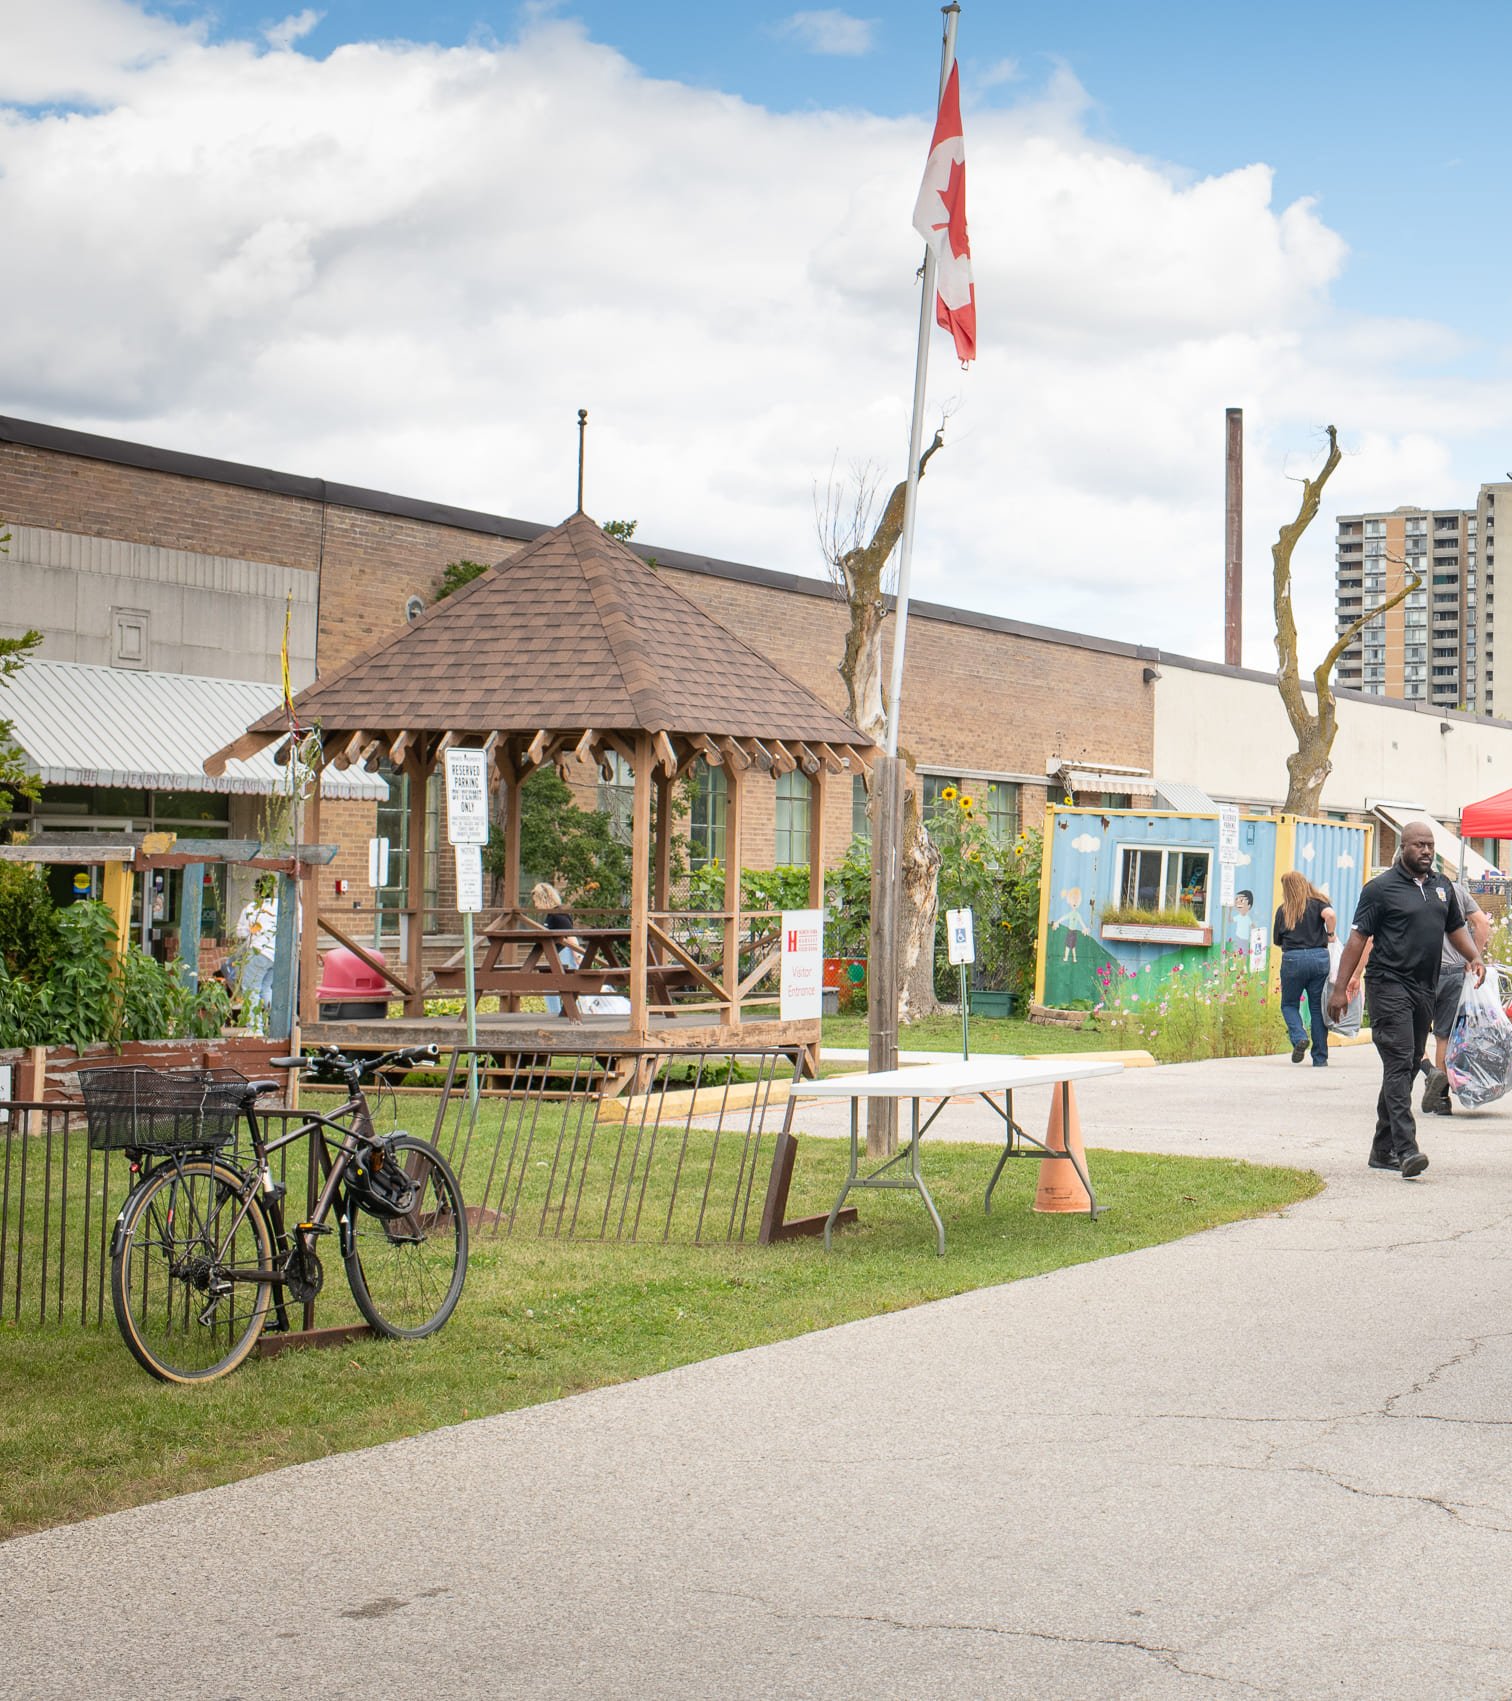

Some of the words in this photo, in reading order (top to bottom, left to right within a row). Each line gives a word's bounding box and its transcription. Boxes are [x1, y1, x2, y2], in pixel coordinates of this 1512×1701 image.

[452, 764, 480, 776] RESERVED
[75, 769, 97, 782] THE
[122, 773, 182, 787] LEARNING
[204, 776, 273, 793] ENRICHMENT
[454, 777, 479, 788] PARKING
[461, 801, 475, 813] ONLY
[787, 930, 798, 952] H
[792, 966, 812, 977] Visitor
[788, 984, 816, 998] Entrance
